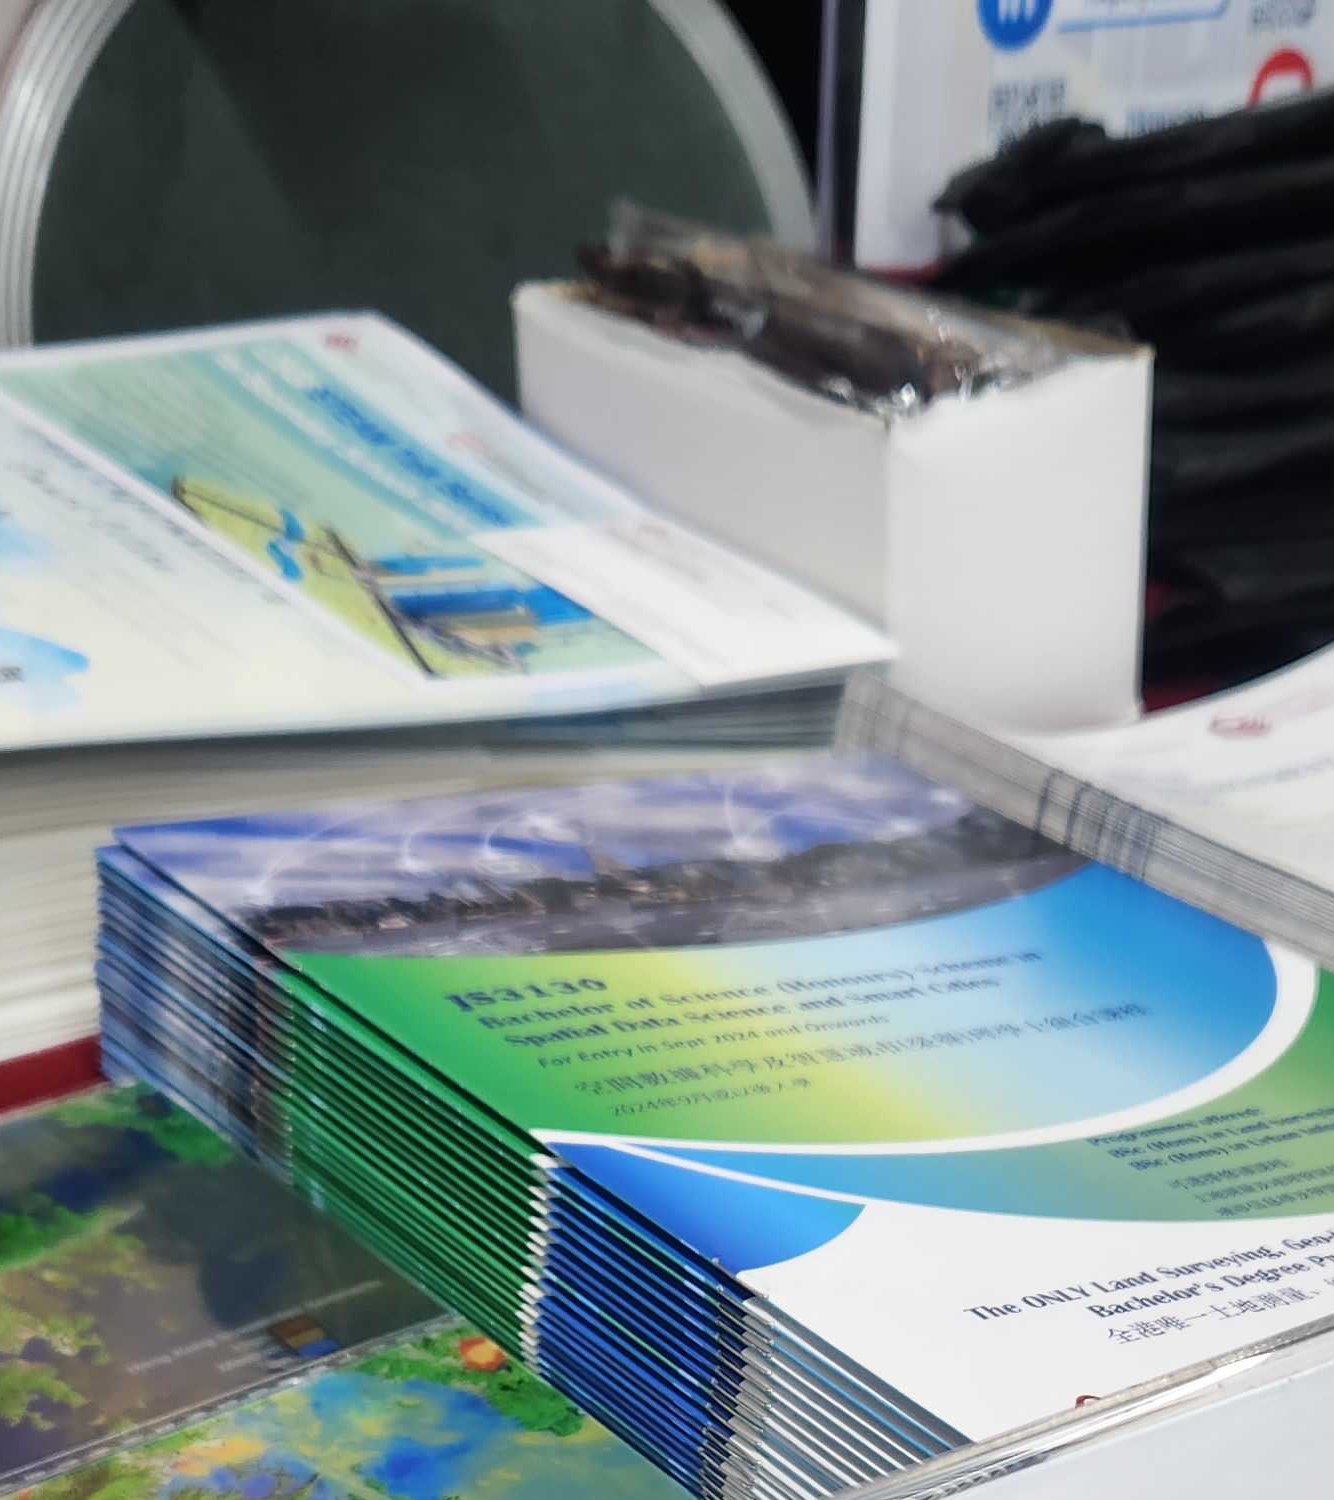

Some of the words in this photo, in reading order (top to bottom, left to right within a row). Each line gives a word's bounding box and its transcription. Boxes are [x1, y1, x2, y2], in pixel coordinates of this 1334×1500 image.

[447, 977, 607, 1012] JS3130
[478, 1001, 617, 1030] Bachelor
[625, 997, 654, 1011] of
[660, 985, 767, 1006] Science
[505, 1024, 610, 1050] Spatial
[611, 1014, 680, 1034] Data
[685, 1003, 791, 1025] Science
[798, 996, 845, 1013] and
[846, 986, 923, 1006] Smart
[928, 976, 1001, 995] Cities
[538, 1057, 571, 1069] For
[578, 1045, 634, 1064] Entry
[637, 1042, 658, 1054] in
[663, 1036, 705, 1052] Sept
[713, 1030, 758, 1044] 2024
[764, 1024, 800, 1038] and
[963, 1301, 1022, 1321] The
[1021, 1284, 1091, 1309] ONLY
[1092, 1269, 1157, 1294] Land
[1159, 1244, 1286, 1280] Surveying,
[1220, 1261, 1311, 1290] Degree
